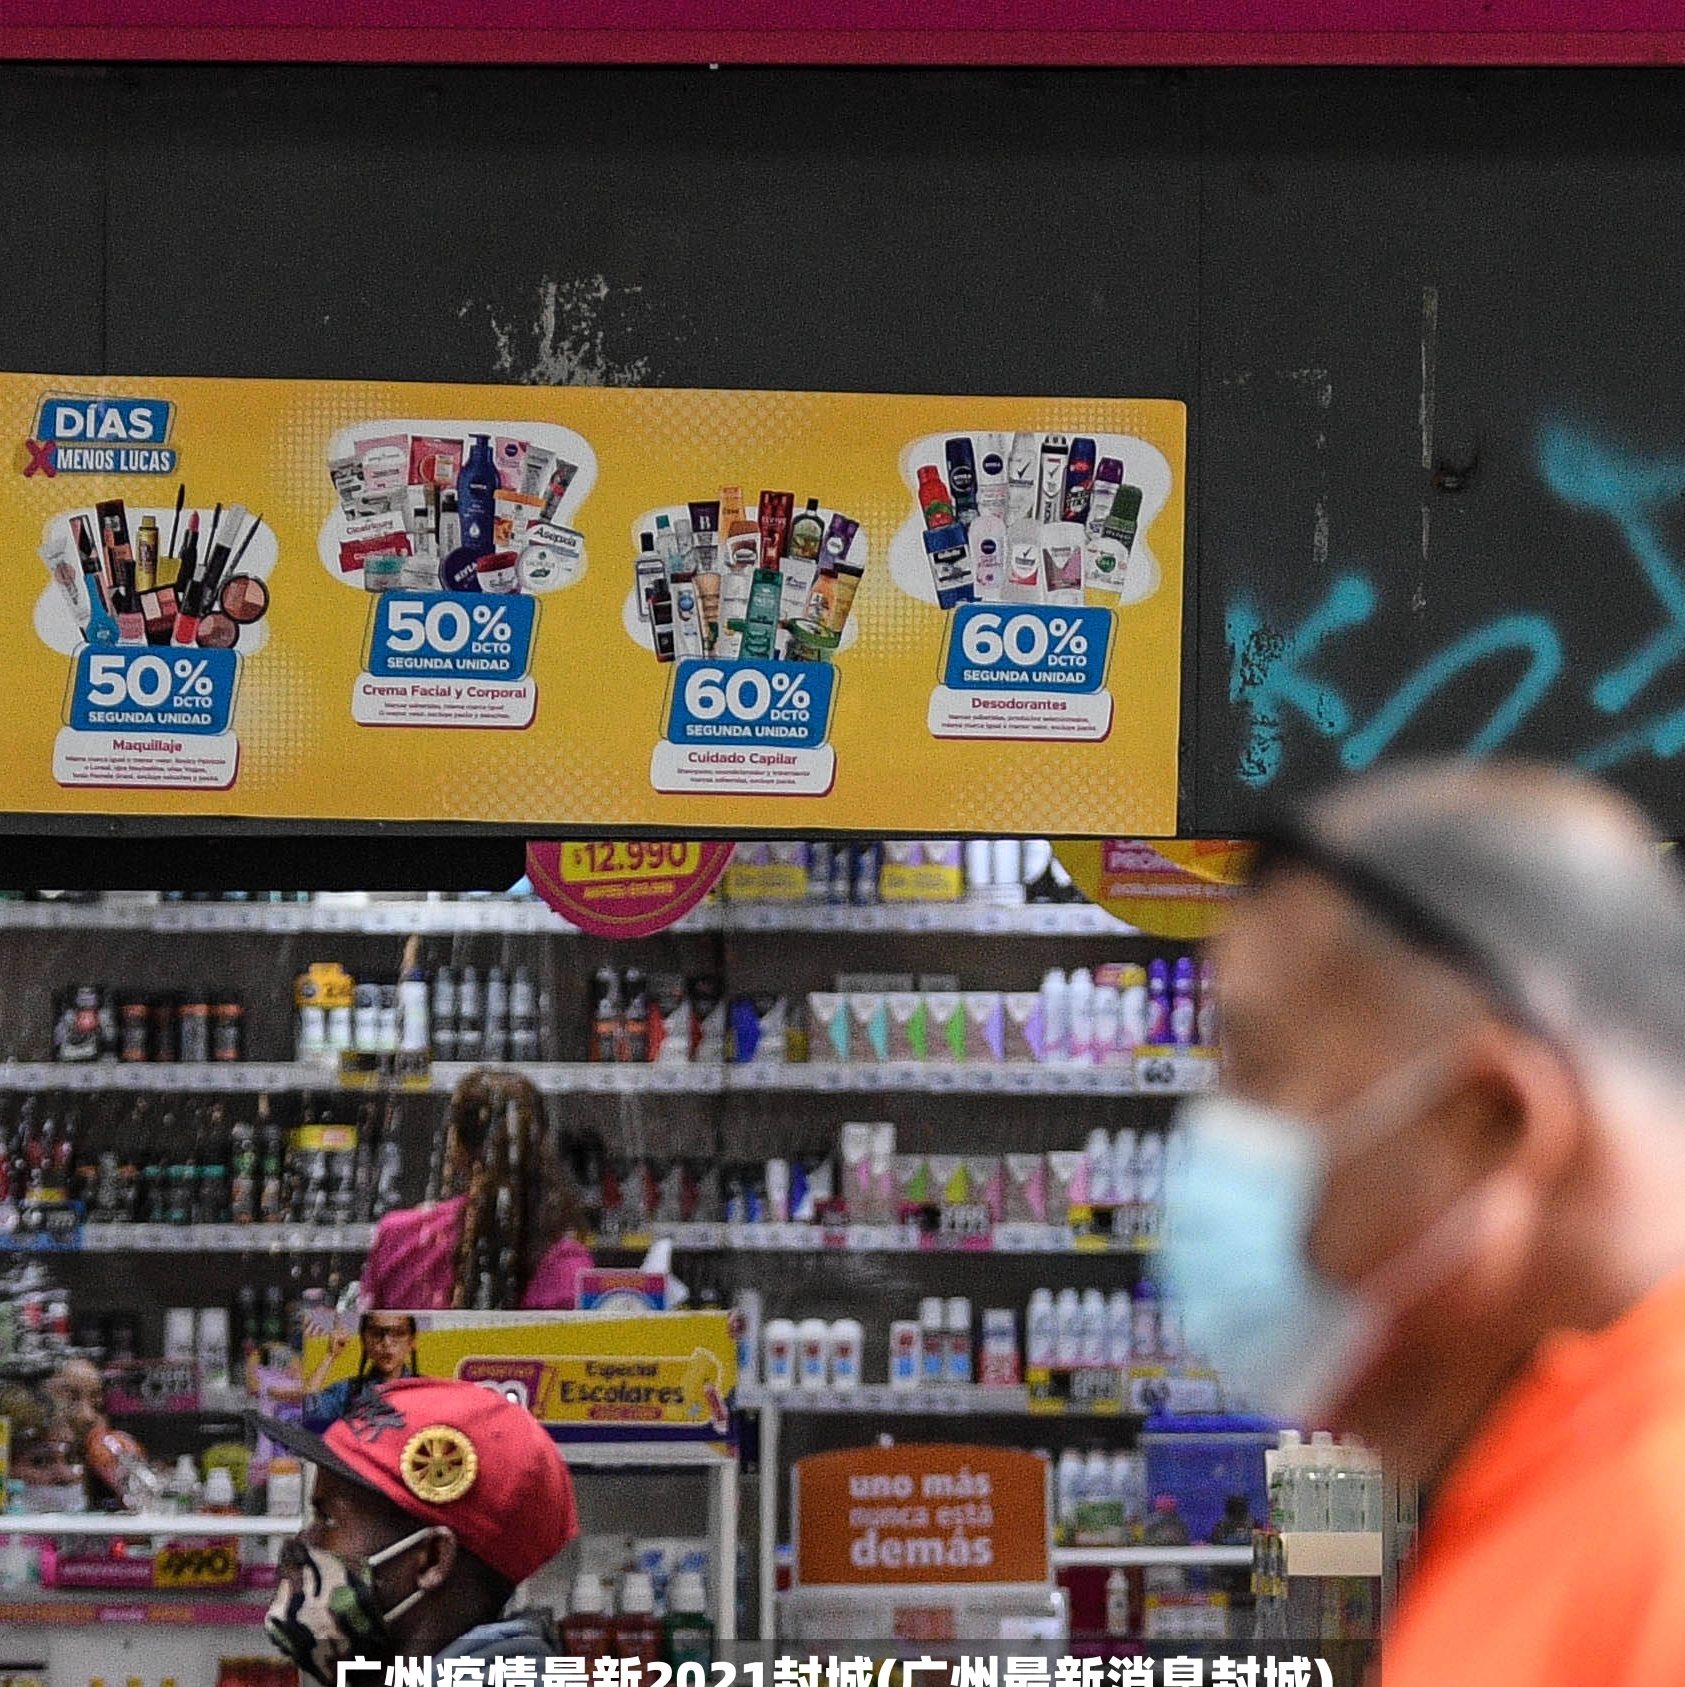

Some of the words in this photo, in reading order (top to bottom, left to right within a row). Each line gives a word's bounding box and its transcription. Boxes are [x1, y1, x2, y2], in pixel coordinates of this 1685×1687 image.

[54, 403, 154, 440] DÍAS
[56, 447, 114, 471] MENOS
[118, 448, 171, 472] LUCAS
[386, 601, 512, 653] 50%
[471, 641, 511, 654] DCTO
[961, 614, 1088, 666] 60%
[386, 657, 452, 670] SEGUNDA
[455, 658, 510, 671] UNIDAD
[1047, 654, 1087, 667] DCTO
[86, 655, 213, 708] 50%
[963, 669, 1028, 683] SEGUNDA
[1032, 670, 1086, 684] UNIDAD
[362, 684, 407, 697] Crema
[410, 684, 451, 698] Facial
[455, 688, 463, 701] y
[466, 686, 527, 701] Corporal
[684, 668, 810, 720] 60%
[971, 697, 1067, 711] Desodorantes
[88, 711, 154, 725] SEGUNDA
[157, 712, 212, 725] UNIDAD
[685, 724, 752, 738] SEGUNDA
[755, 725, 809, 738] UNIDAD
[112, 737, 183, 754] Maquillaje
[688, 751, 745, 765] Cuidado
[749, 751, 798, 767] Capilar
[560, 1381, 685, 1405] Escolares
[850, 1474, 912, 1498] uno
[923, 1471, 992, 1498] más
[850, 1535, 993, 1568] demás
